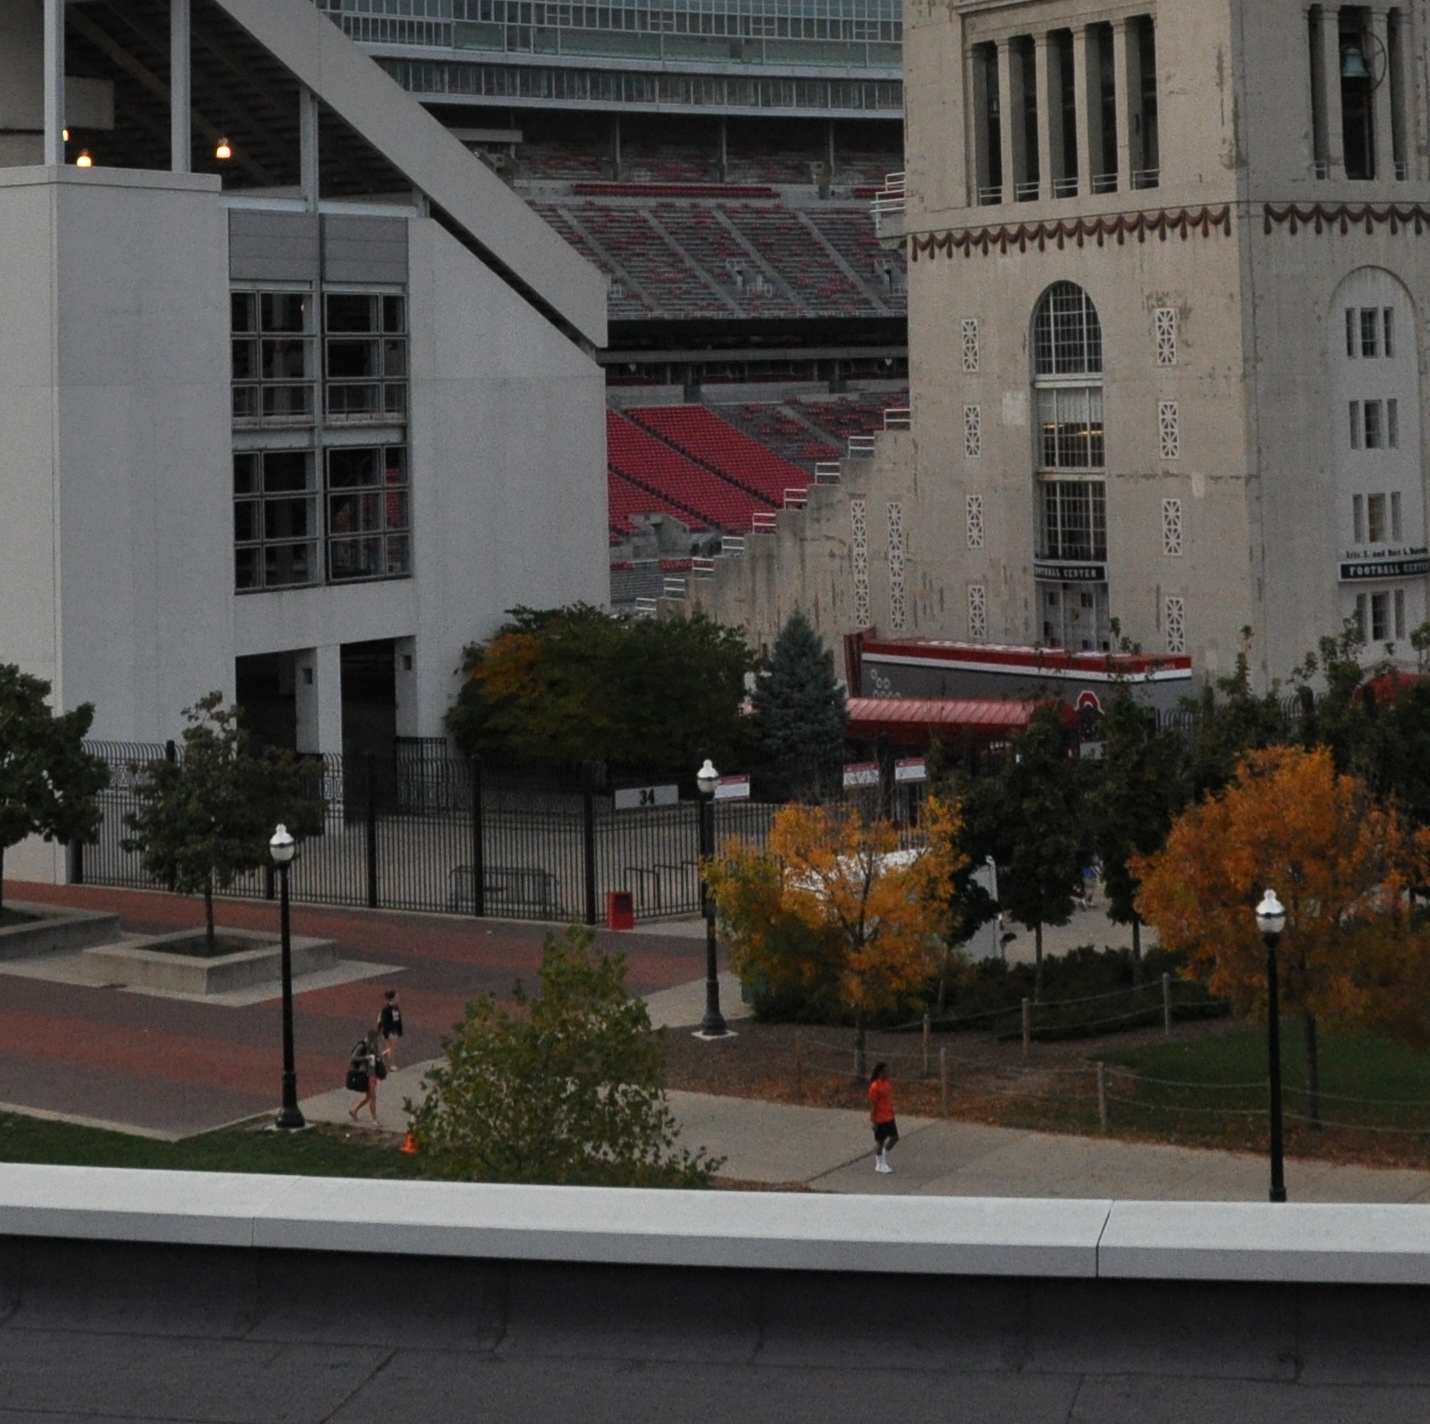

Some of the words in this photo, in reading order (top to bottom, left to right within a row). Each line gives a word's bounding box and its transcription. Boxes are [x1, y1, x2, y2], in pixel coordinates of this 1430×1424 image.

[1063, 568, 1098, 578] CENTER
[1350, 564, 1400, 576] FOOTBALL
[639, 788, 655, 805] 34
